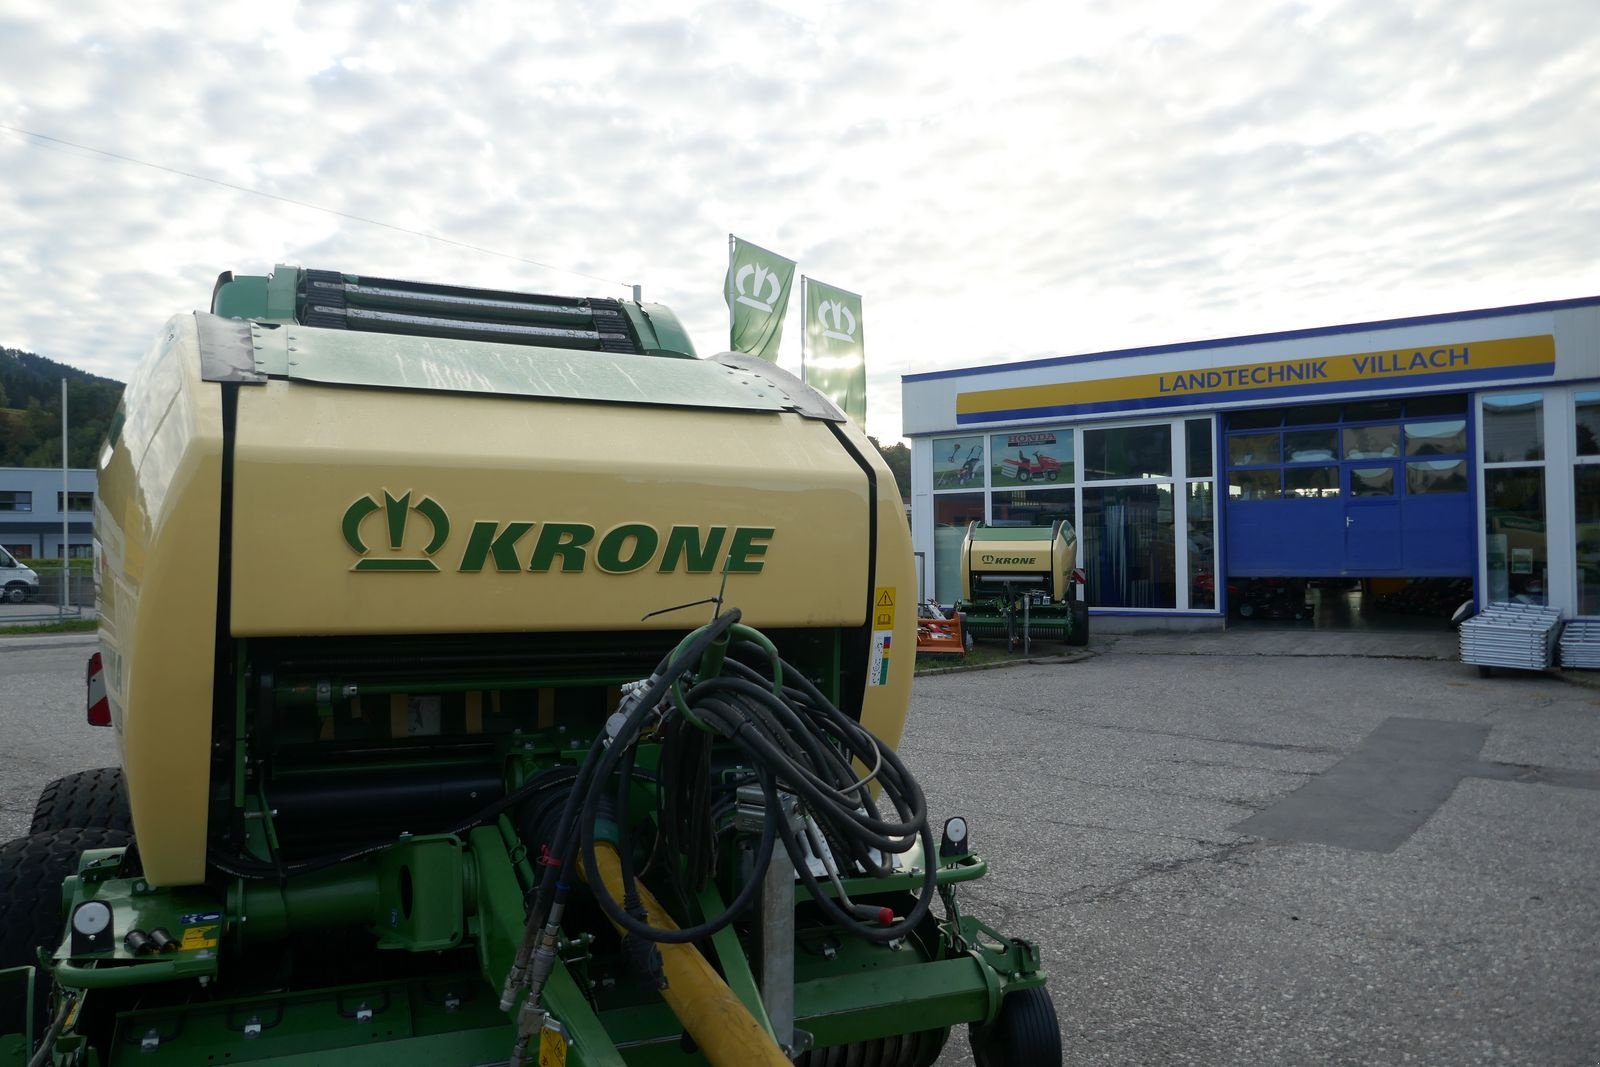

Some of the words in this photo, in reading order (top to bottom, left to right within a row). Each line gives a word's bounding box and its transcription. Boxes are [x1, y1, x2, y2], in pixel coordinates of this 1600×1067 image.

[1159, 361, 1327, 392] LANDTECHNIK
[1352, 348, 1469, 375] VILLACH
[1008, 432, 1056, 442] HONDA
[456, 521, 776, 574] KRONE
[995, 557, 1036, 565] KRONE
